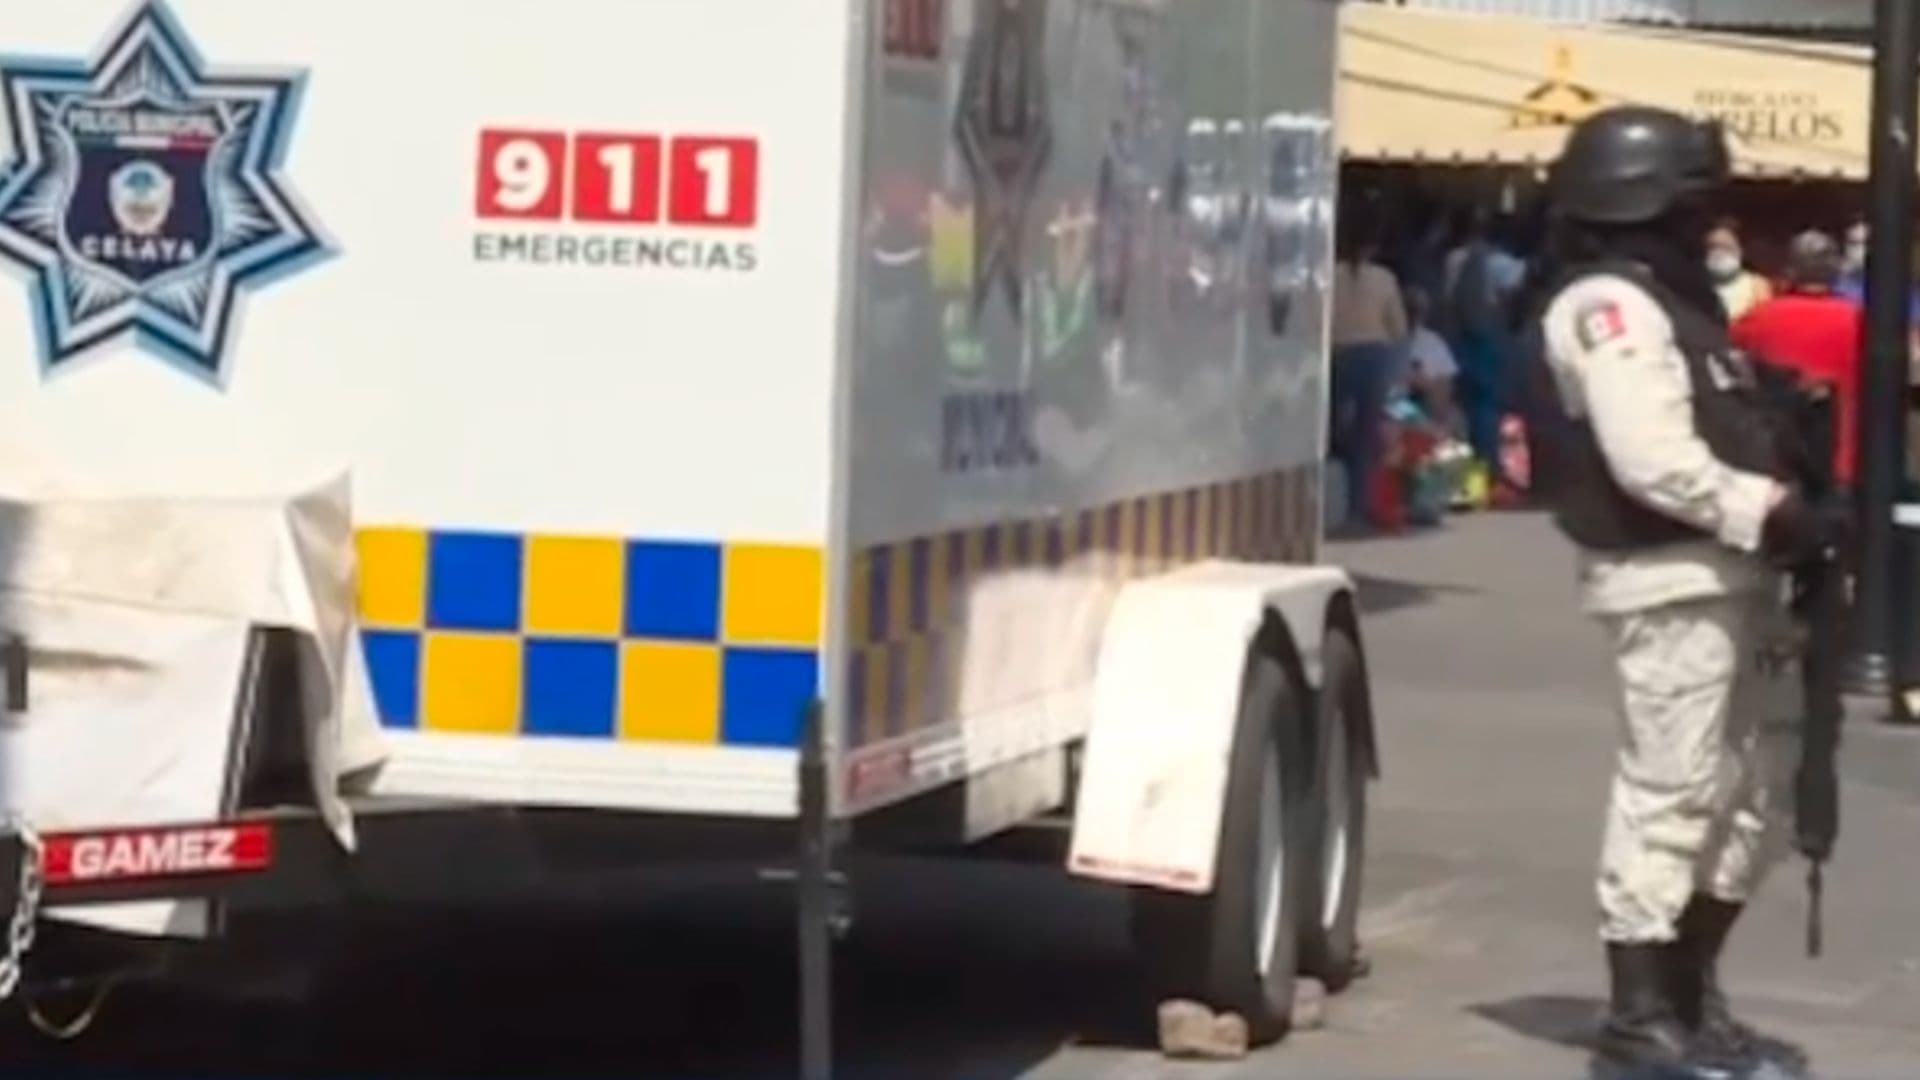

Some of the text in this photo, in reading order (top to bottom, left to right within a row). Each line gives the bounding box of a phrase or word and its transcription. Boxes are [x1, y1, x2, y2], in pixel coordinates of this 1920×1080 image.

[493, 138, 732, 217] 911
[80, 234, 197, 261] CELAYA
[473, 232, 758, 273] EMERGENCIAS
[70, 828, 238, 880] GAMEZ
